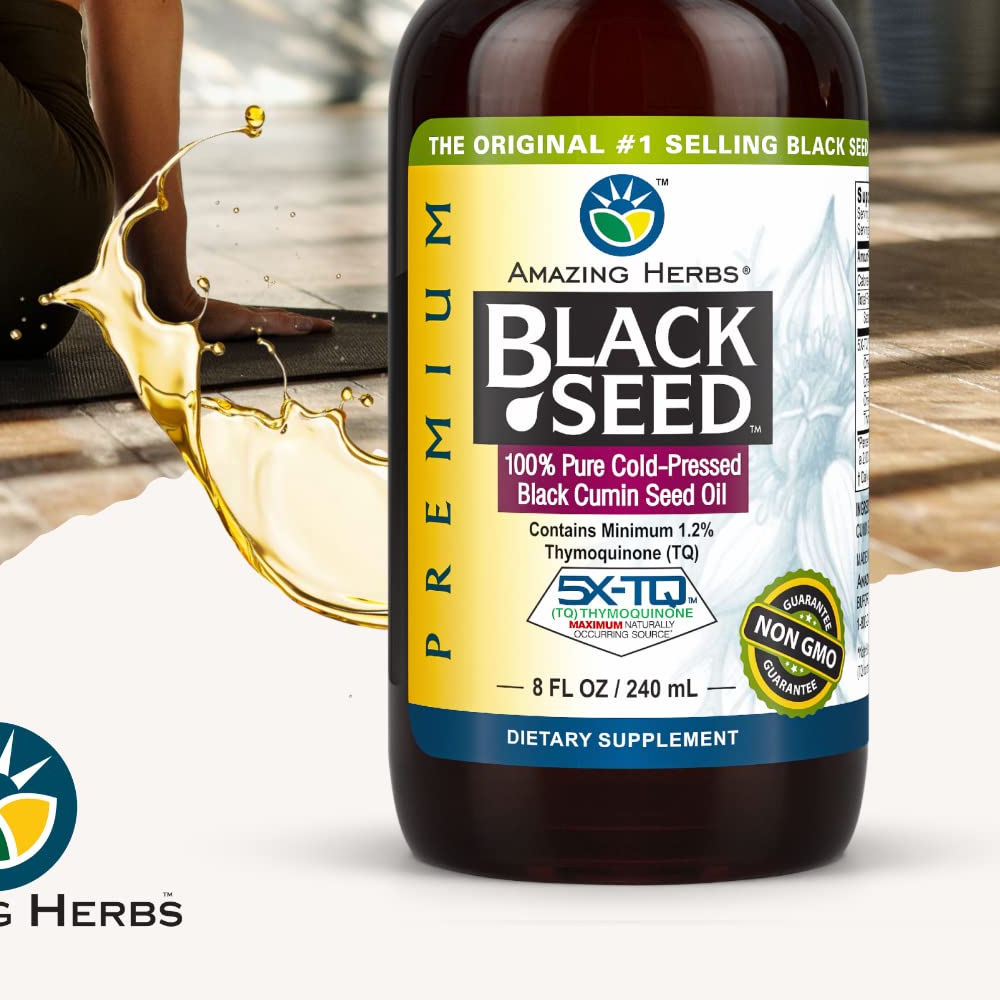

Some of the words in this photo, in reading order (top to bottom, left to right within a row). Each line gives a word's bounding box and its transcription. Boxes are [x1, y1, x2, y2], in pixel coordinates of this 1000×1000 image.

[429, 136, 464, 155] THE
[474, 135, 604, 154] ORIGINAL
[616, 135, 650, 154] #1
[666, 135, 777, 154] SELLING
[788, 136, 845, 155] BLACK
[850, 138, 868, 156] SEED
[508, 262, 628, 283] AMAZING
[486, 303, 758, 389] BLACK
[551, 373, 752, 436] SEED
[426, 203, 451, 659] PREMIUM
[505, 453, 555, 476] 100%
[563, 454, 604, 477] Pure
[612, 453, 741, 477] Cold-Pressed
[518, 482, 569, 505] Black
[575, 483, 638, 506] Cumin
[646, 483, 694, 506] Seed
[702, 483, 726, 505] Oil
[530, 522, 596, 537] Contains
[602, 523, 672, 537] Minimum
[679, 522, 713, 537] 1.2%
[545, 544, 661, 563] Thymoquinone
[667, 545, 698, 563] (TQ)
[558, 575, 687, 608] 5X-TQ
[552, 608, 577, 620] (TQ)
[580, 607, 694, 619] THYMOQUINONE
[783, 594, 832, 632] GUARANTEE
[569, 620, 623, 630] MAXIMUM
[572, 630, 628, 640] OCCURRING
[754, 615, 800, 650] NON
[801, 637, 837, 669] GMO
[533, 678, 542, 696] 8
[550, 678, 573, 697] FL
[580, 679, 608, 697] OZ
[627, 680, 660, 698] 240
[669, 679, 698, 697] mL
[763, 659, 818, 696] GUARANTEE
[508, 730, 592, 747] DIETARY
[599, 730, 738, 747] SUPPLEMENT
